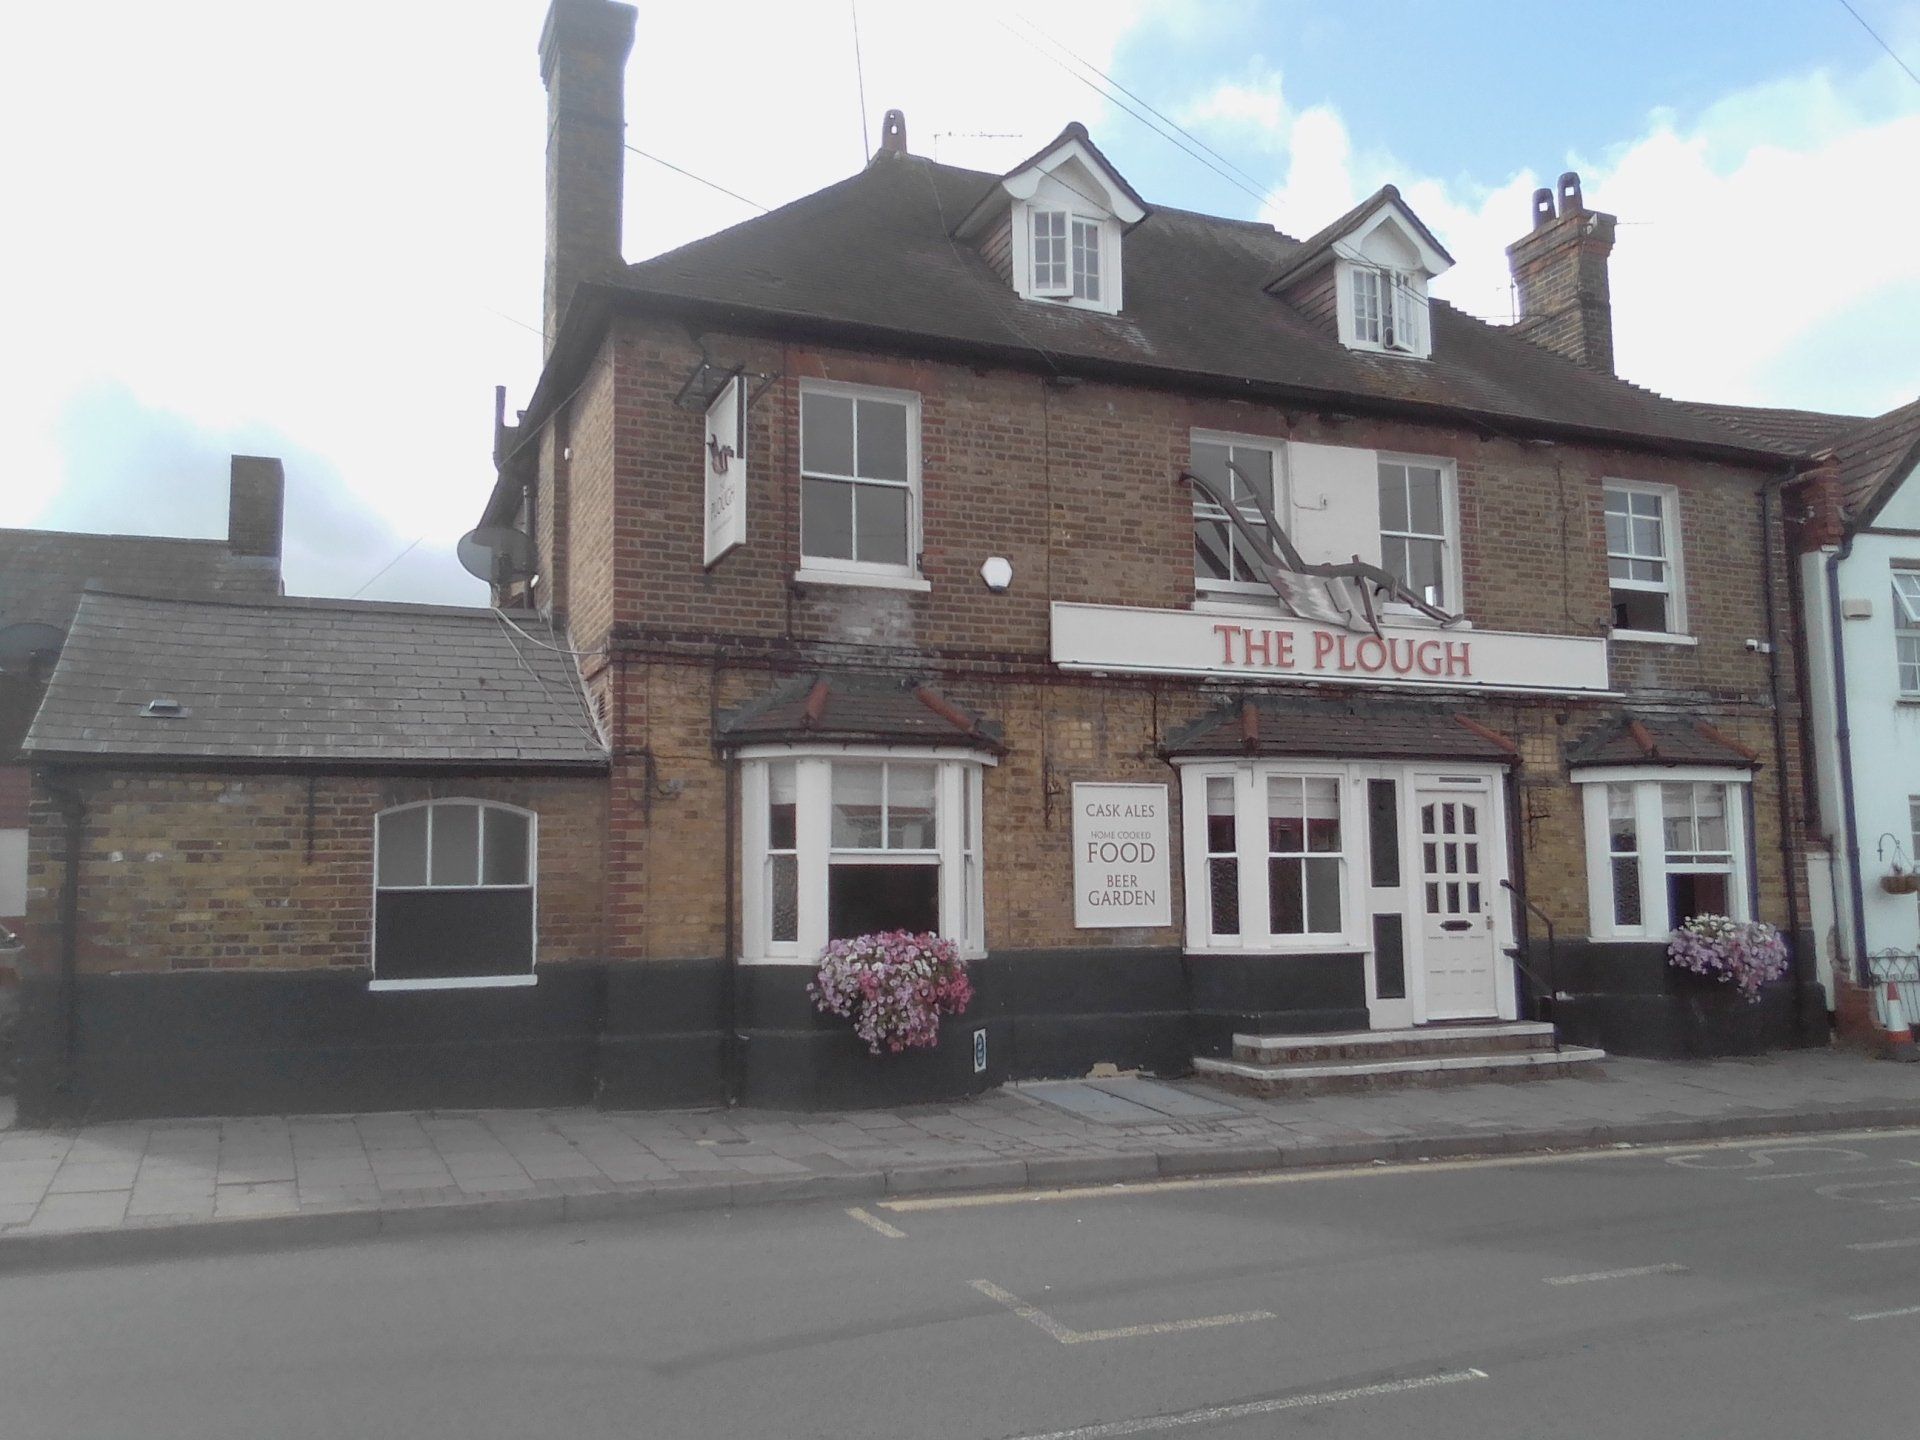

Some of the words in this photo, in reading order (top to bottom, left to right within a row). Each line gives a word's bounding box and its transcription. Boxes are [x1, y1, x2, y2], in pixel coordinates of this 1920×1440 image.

[1213, 624, 1295, 668] THE
[1313, 630, 1472, 677] PLOUGH
[1085, 803, 1121, 818] CASK
[1124, 804, 1155, 818] ALES
[1090, 830, 1115, 840] HOME
[1117, 831, 1151, 840] COOKED
[1087, 842, 1156, 864] FOOD
[1107, 874, 1138, 888] BEER
[1088, 889, 1156, 907] GARDEN
